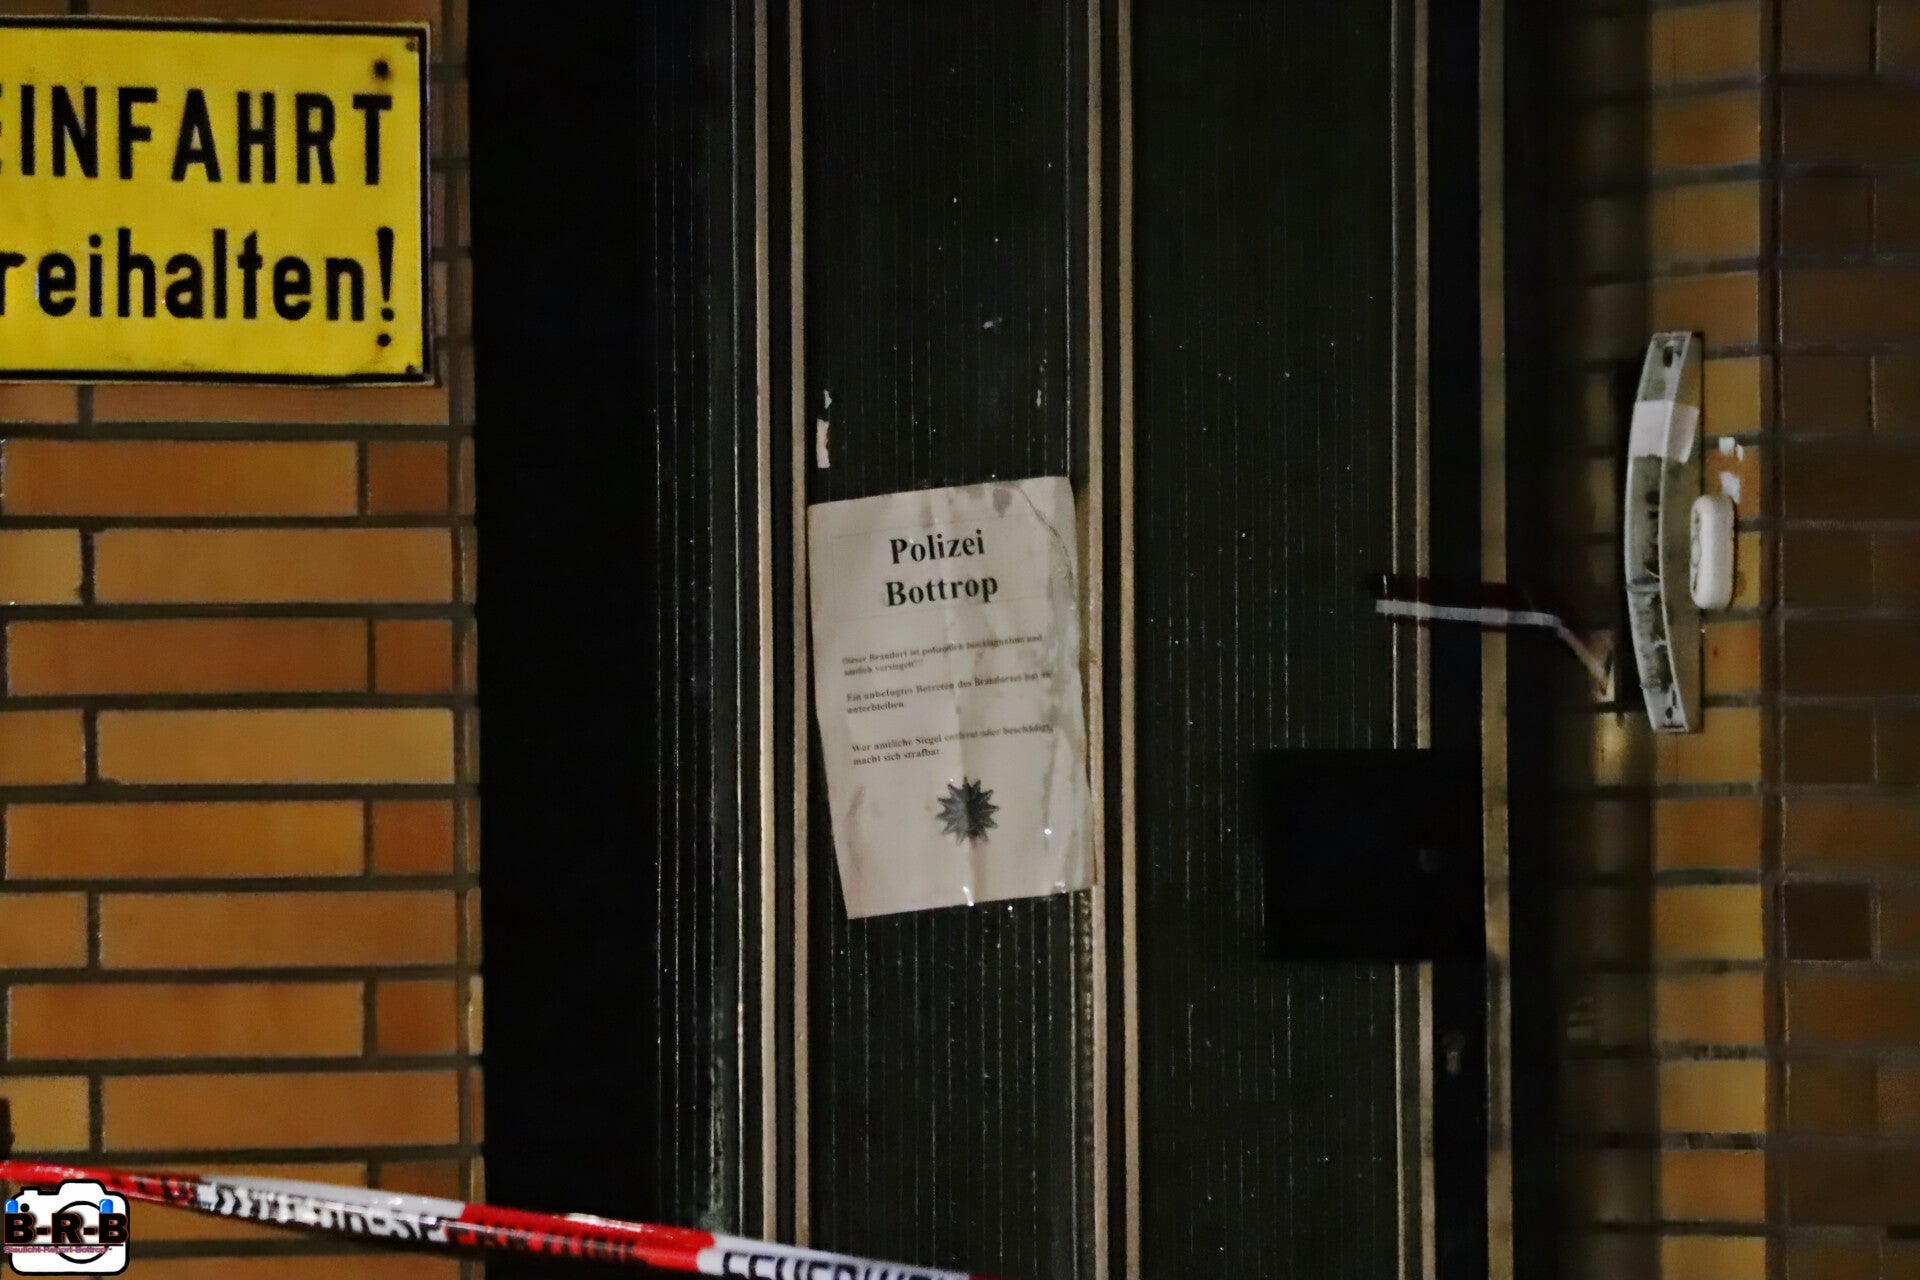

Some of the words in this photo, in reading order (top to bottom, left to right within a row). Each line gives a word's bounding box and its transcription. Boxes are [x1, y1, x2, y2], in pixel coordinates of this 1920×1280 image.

[0, 84, 393, 186] INFAHRT
[889, 528, 985, 565] Polizei
[885, 576, 999, 607] Bottrop
[957, 680, 972, 689] des
[851, 744, 871, 752] Wer
[915, 734, 942, 745] Siegel
[853, 755, 880, 766] macht
[883, 752, 901, 761] sich
